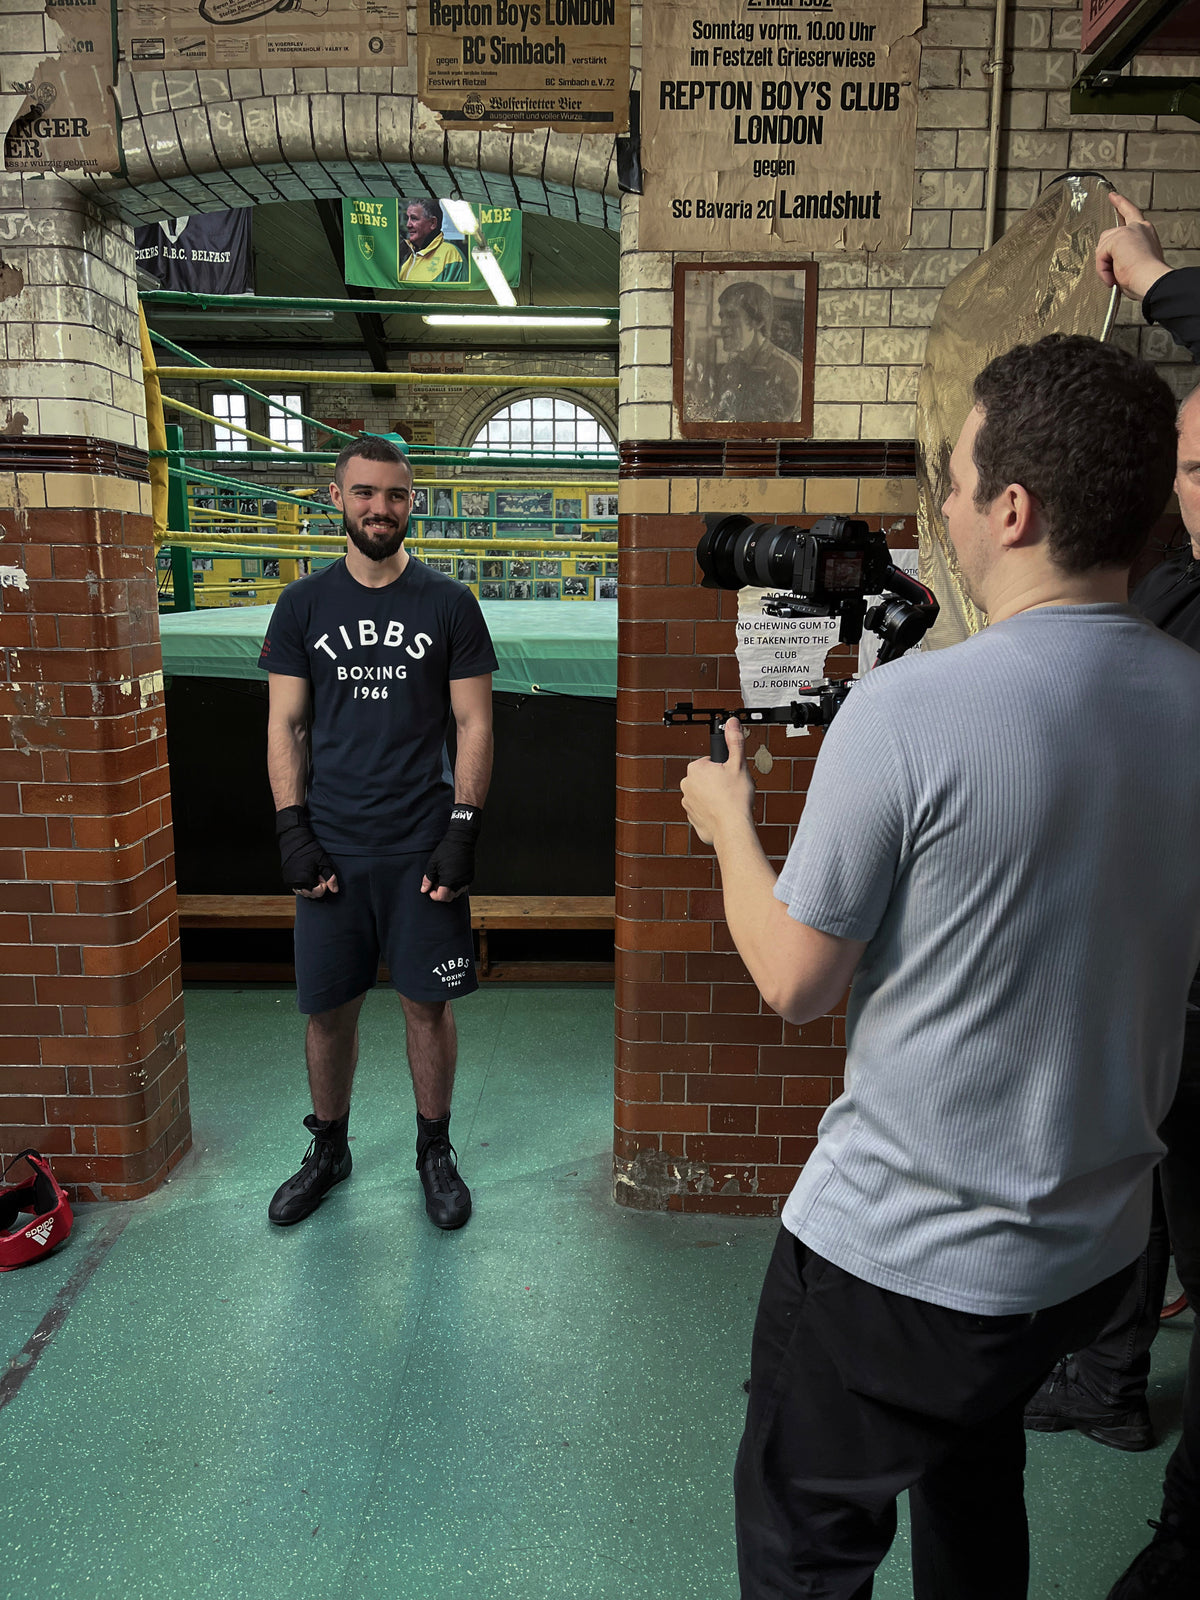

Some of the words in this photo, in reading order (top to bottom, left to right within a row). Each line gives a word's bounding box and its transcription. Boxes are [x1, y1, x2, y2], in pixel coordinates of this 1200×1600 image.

[430, 0, 492, 32] Repton
[496, 0, 541, 32] Boys
[545, 0, 615, 25] LONDON
[692, 20, 754, 42] Sonntag
[759, 21, 801, 41] vorm.
[806, 21, 845, 41] 10.00
[849, 22, 876, 41] Uhr
[436, 57, 458, 66] gegen
[463, 36, 485, 64] BC
[490, 36, 565, 64] Simbach
[572, 56, 607, 64] verstärkt
[690, 47, 708, 66] im
[713, 47, 773, 67] Festzelt
[777, 48, 876, 67] Grieserwiese
[429, 78, 460, 86] Festwirt
[660, 80, 752, 110] REPTON
[761, 81, 832, 111] BOY'S
[841, 82, 900, 111] CLUB
[558, 97, 582, 110] Bier
[526, 112, 540, 120] und
[541, 112, 559, 120] voller
[6, 117, 91, 138] NGER
[734, 115, 823, 145] LONDON
[63, 158, 98, 169] gebraut
[753, 159, 796, 177] gegen
[353, 201, 384, 215] TONY
[672, 199, 692, 218] SC
[696, 199, 751, 219] Bavaria
[757, 200, 774, 219] 20
[780, 190, 881, 220] Landshut
[350, 213, 388, 228] BURNS
[481, 208, 512, 224] MBE
[163, 246, 188, 261] A.B.C.
[191, 249, 231, 262] BELFAST
[411, 352, 464, 364] BOXEN
[738, 622, 752, 630] NO
[754, 621, 797, 630] CHEWING
[799, 621, 821, 630] GUM
[824, 621, 836, 629] TO
[314, 619, 433, 661] TIBBS
[743, 637, 754, 645] BE
[757, 636, 786, 645] TAKEN
[788, 636, 810, 644] INTO
[812, 636, 829, 644] THE
[775, 651, 797, 659] CLUB
[337, 665, 407, 680] BOXING
[761, 665, 810, 674] CHAIRMAN
[353, 686, 389, 700] 1966
[432, 957, 470, 976] TIBBS
[441, 971, 466, 983] BOXING
[447, 980, 461, 988] 1966
[25, 1217, 54, 1238] adidas
